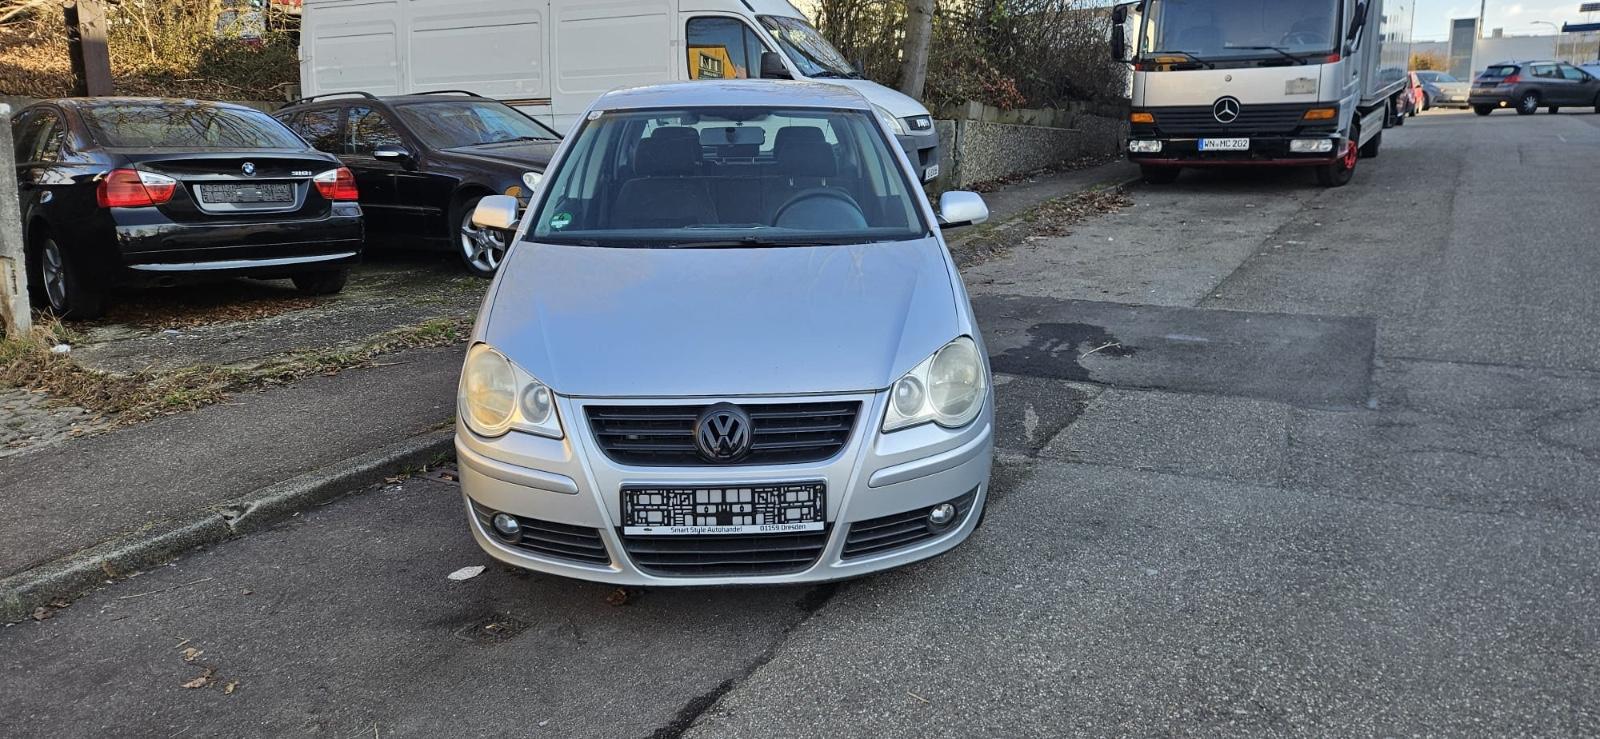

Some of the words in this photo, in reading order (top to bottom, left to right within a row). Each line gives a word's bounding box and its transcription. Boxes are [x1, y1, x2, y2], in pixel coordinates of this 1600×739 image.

[699, 412, 749, 458] VW
[690, 526, 707, 534] Style
[707, 525, 743, 533] Autohandel
[760, 524, 780, 532] 01159
[781, 523, 807, 531] Dresden
